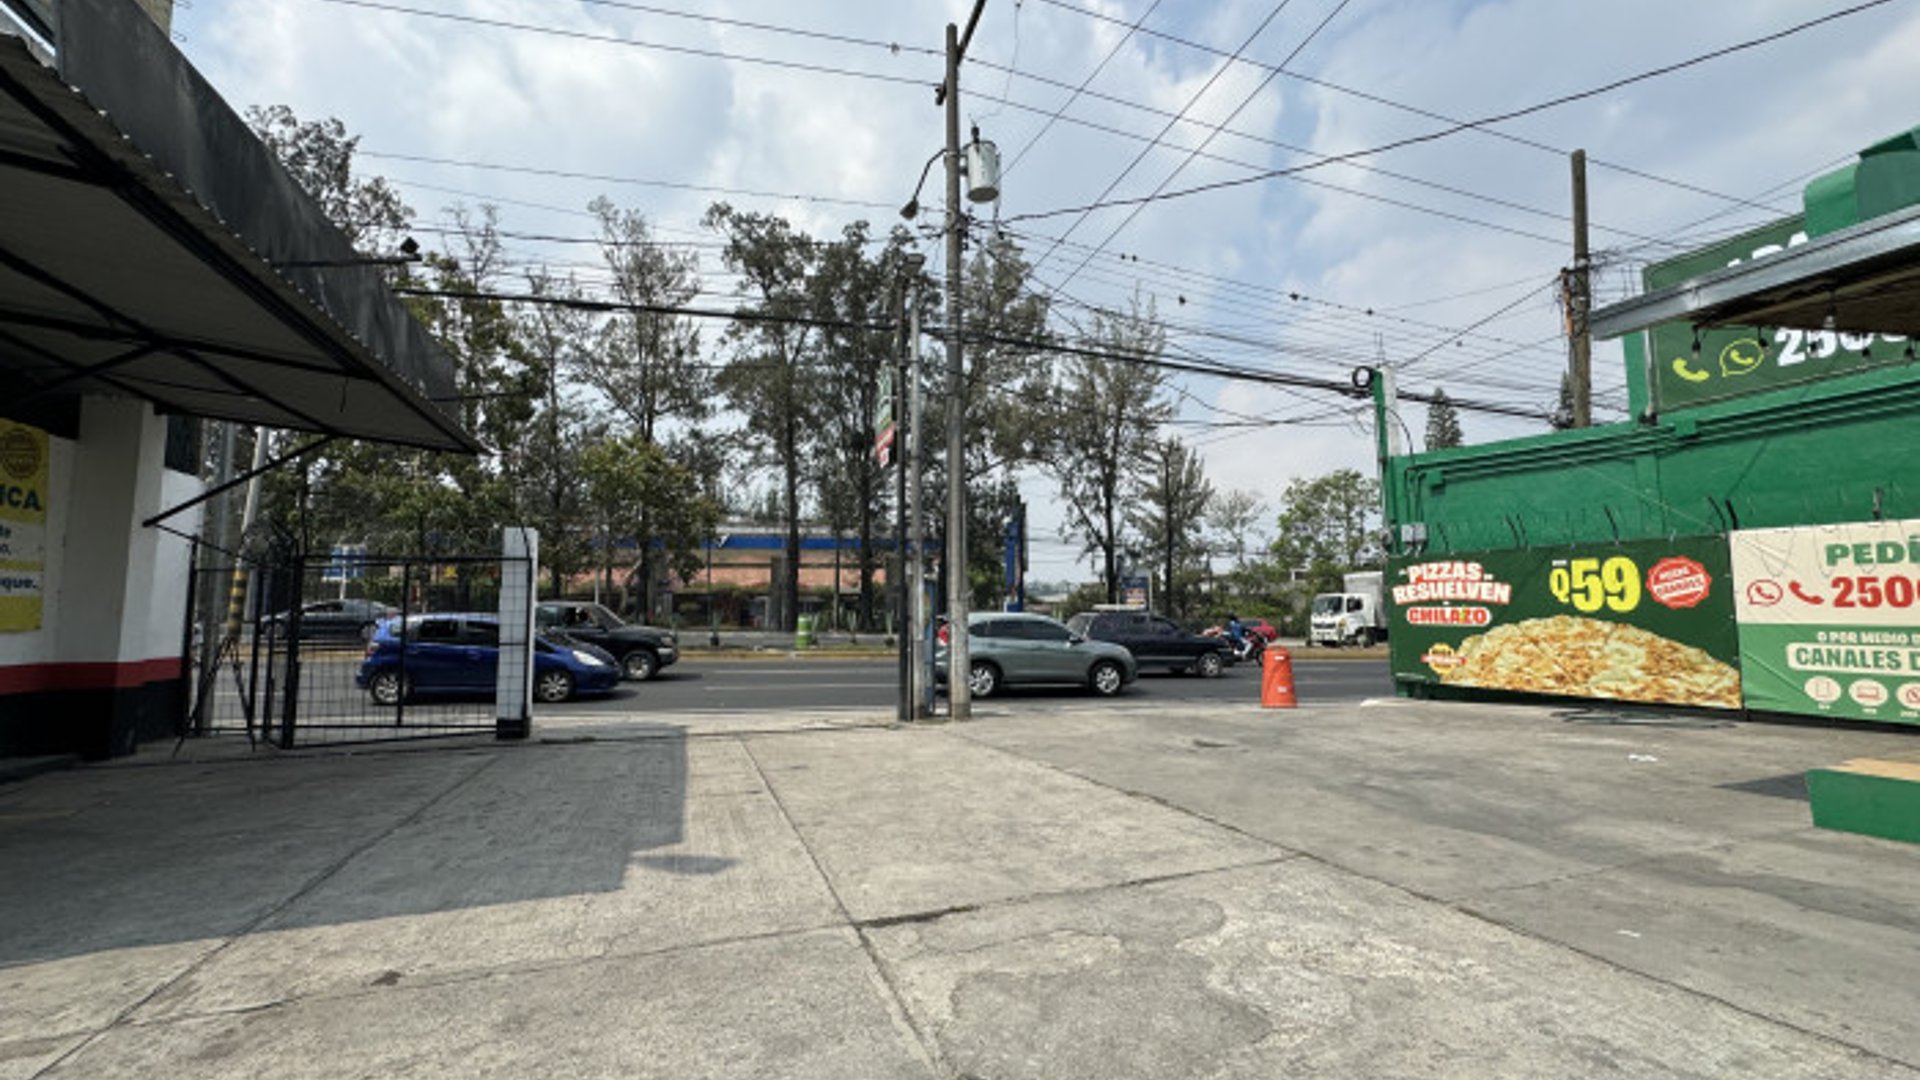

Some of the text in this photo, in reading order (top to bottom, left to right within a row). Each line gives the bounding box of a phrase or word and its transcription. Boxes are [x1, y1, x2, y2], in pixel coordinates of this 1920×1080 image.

[1408, 561, 1484, 584] PIZZAS
[1392, 581, 1511, 605] RESUELVEN
[1831, 575, 1920, 608] 250
[1408, 607, 1488, 624] CHILAZO
[1796, 647, 1902, 671] CANALES
